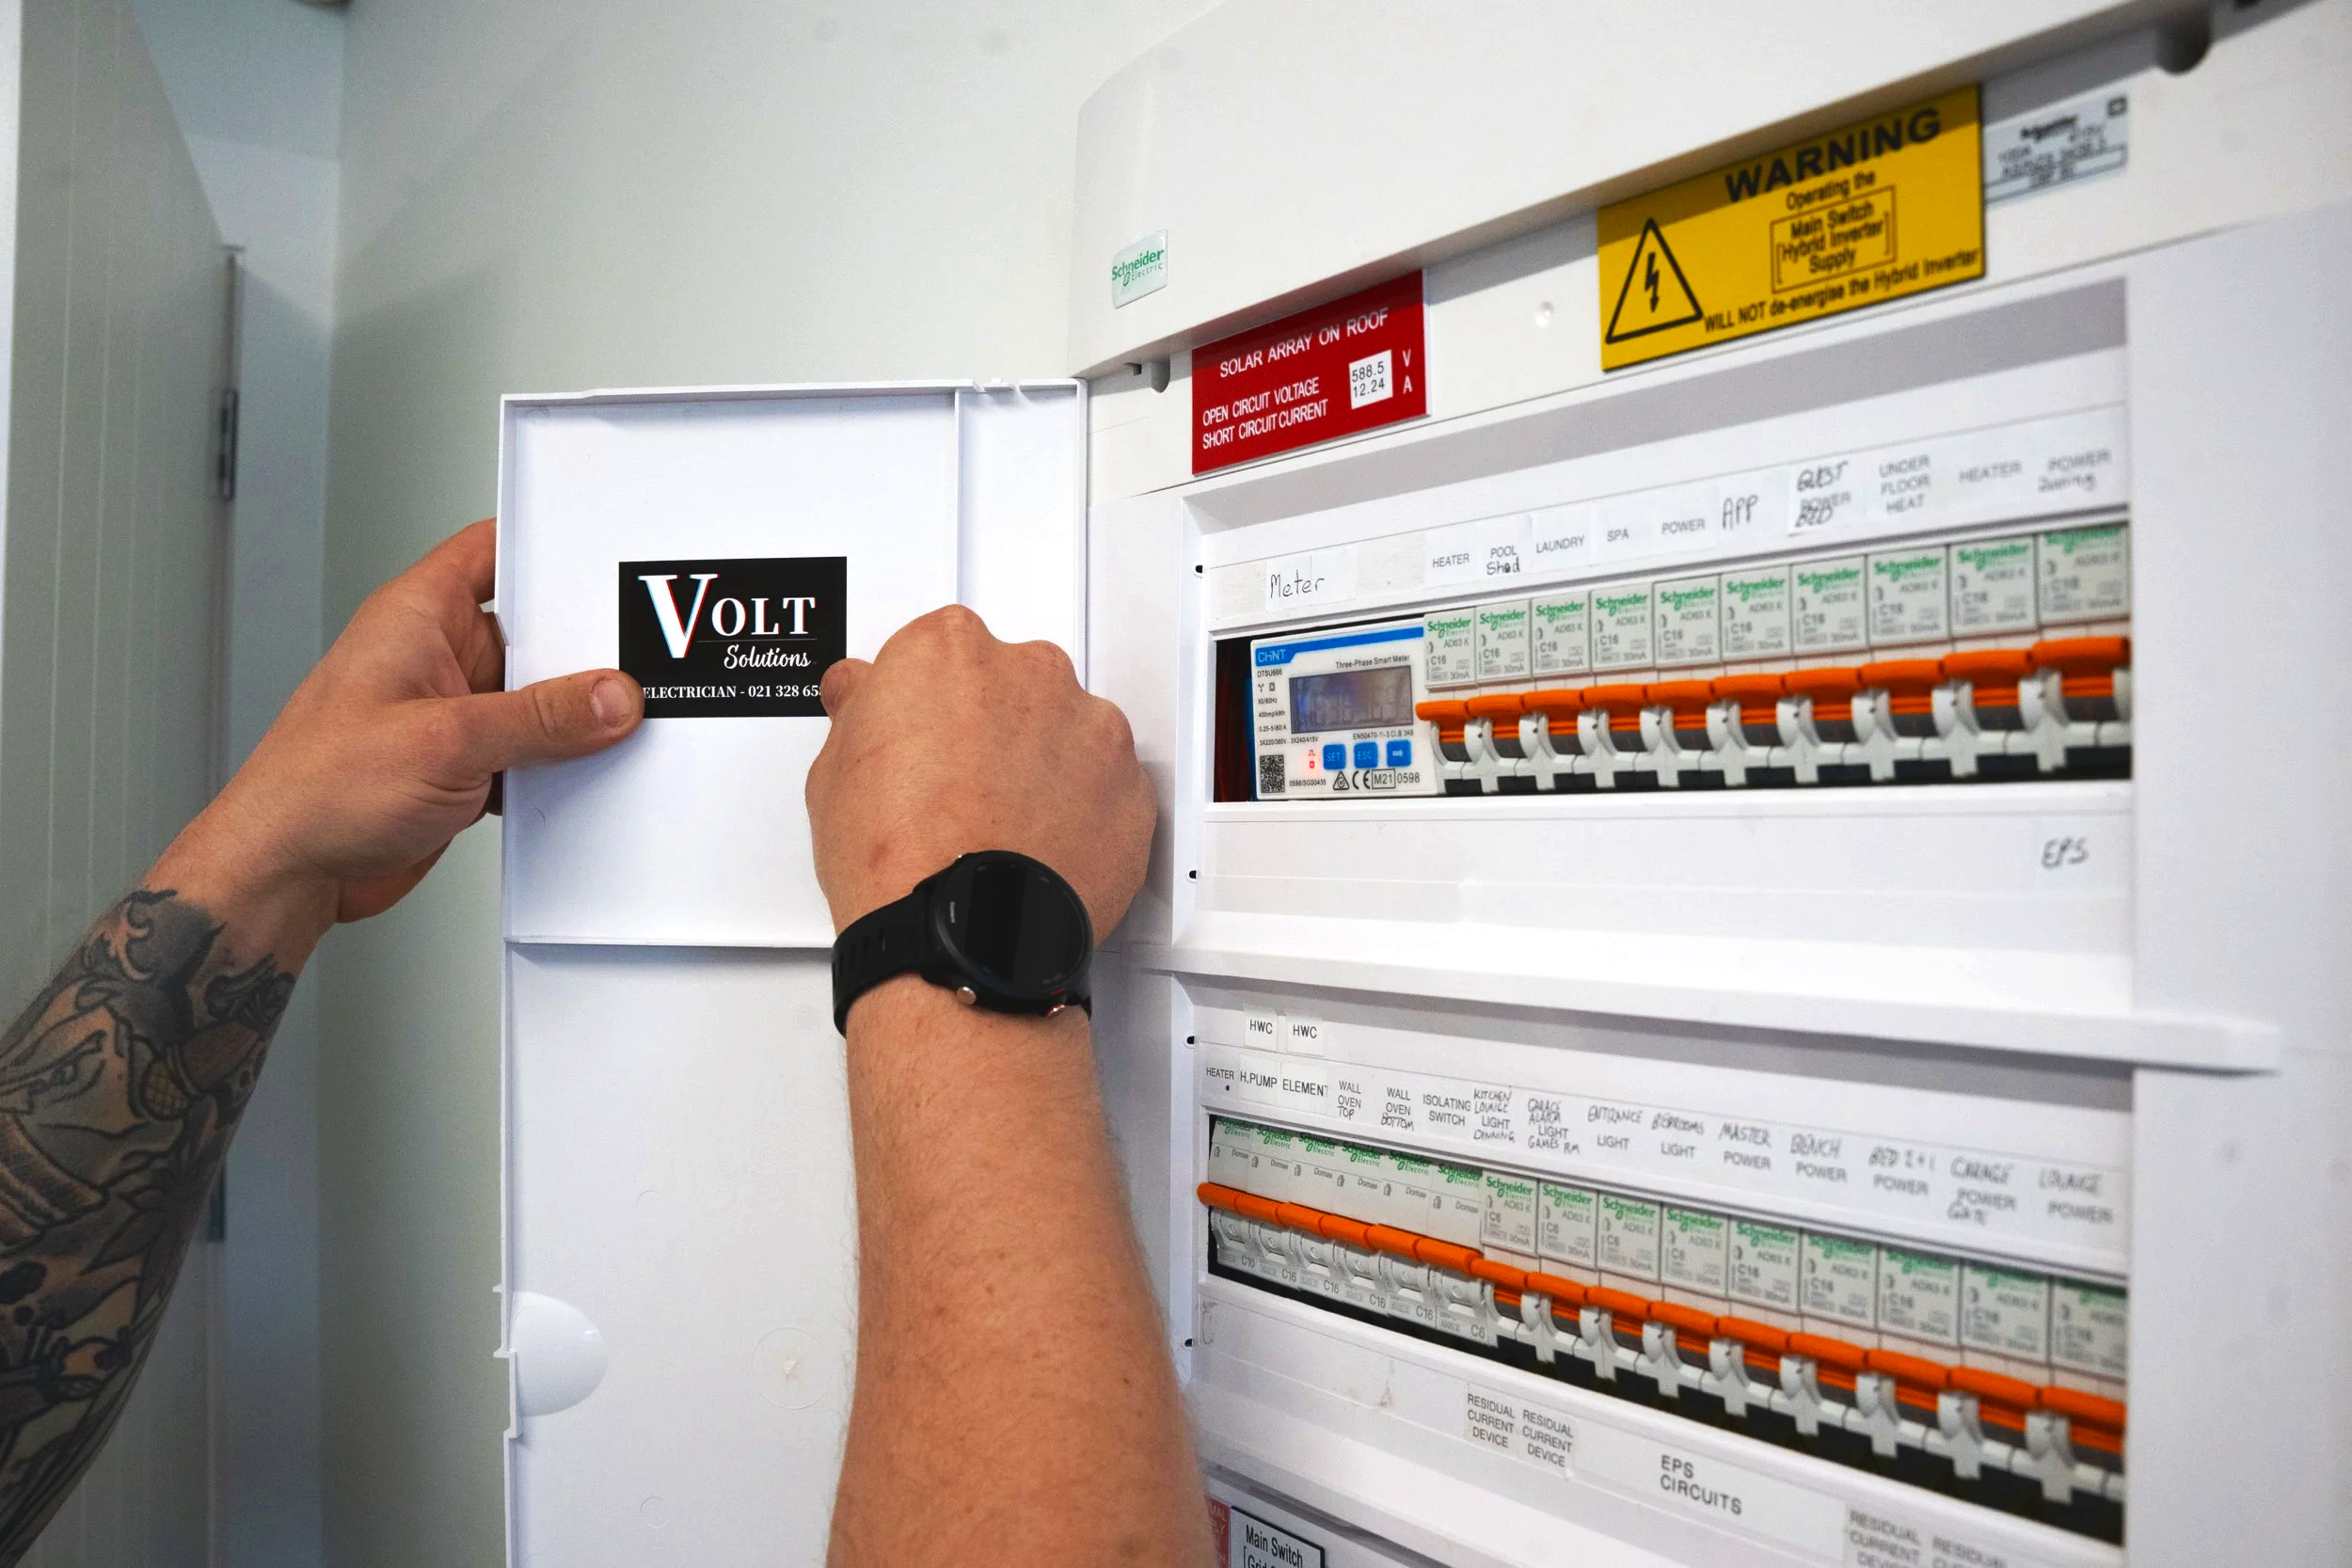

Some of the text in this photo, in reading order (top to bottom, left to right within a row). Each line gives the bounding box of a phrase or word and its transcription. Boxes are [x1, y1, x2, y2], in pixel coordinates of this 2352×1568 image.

[1725, 107, 1942, 203] WARNING
[1786, 170, 1877, 212] Operating the
[1790, 200, 1875, 239] Main Switch
[1782, 218, 1885, 263] Hybrid Inverter
[1111, 249, 1164, 281] Schneider
[1808, 247, 1857, 276] Supply
[1132, 262, 1163, 280] Electric
[1703, 248, 1978, 334] WILL NOT de-energise the Hybrid Inverter
[1219, 307, 1390, 378] SOLAR ARRAY ON ROOF
[1402, 348, 1411, 368] V
[1351, 360, 1385, 384] 588.5
[1352, 377, 1385, 399] 12.24
[1402, 374, 1412, 395] A
[1202, 376, 1320, 427] OPEN CIRCUIT VOLTAGE
[1202, 399, 1328, 451] SHORT CIRCUIT CURRENT
[1879, 455, 1931, 476] UNDER
[1959, 461, 2022, 483] HEATER
[1880, 475, 1931, 496] FLOOR
[1886, 493, 1926, 515] HEAT
[1661, 518, 1705, 535] POWER
[1535, 535, 1585, 554] LAUNDRY
[1607, 529, 1629, 543] SPA
[1432, 553, 1470, 569] HEATER
[1490, 545, 1518, 560] POOL
[1270, 569, 1325, 599] Meter
[1596, 594, 1648, 610] Schneider
[1661, 588, 1715, 604] Schneider
[638, 573, 817, 658] VOLT
[1479, 610, 1526, 625] Schneider
[1535, 601, 1585, 617] Schneider
[1427, 617, 1471, 632] Schneider
[723, 643, 811, 670] Solutions
[1430, 656, 1447, 665] C16
[1483, 648, 1501, 659] C16
[1336, 658, 1373, 670] Three-Phase
[1374, 657, 1392, 665] Smart
[644, 686, 737, 699] ELECTRICIAN
[749, 685, 773, 698] 021
[775, 685, 800, 698] 328
[1327, 752, 1342, 763] SET
[1357, 751, 1374, 761] ESC
[1375, 773, 1392, 784] M21
[1396, 772, 1421, 784] 0598
[1249, 1020, 1274, 1035] HWC
[1293, 1024, 1317, 1039] HWC
[1205, 1067, 1234, 1081] HEATER
[1240, 1070, 1278, 1088] H.PUMP
[1282, 1079, 1328, 1098] ELEMENT
[1338, 1080, 1362, 1095] WALL
[1386, 1086, 1411, 1101] WALL
[1473, 1088, 1513, 1102] KITCHEN
[1338, 1095, 1362, 1110] OVEN
[1385, 1101, 1411, 1117] OVEN
[1422, 1094, 1471, 1113] ISOLATING
[1337, 1105, 1356, 1120] TOP
[1428, 1110, 1466, 1127] SWITCH
[1380, 1112, 1415, 1131] BOTTOM
[1482, 1116, 1511, 1130] LIGHT
[1231, 1131, 1250, 1139] Electric
[1257, 1128, 1293, 1143] Schneider
[1298, 1132, 1336, 1149] Schneider
[1538, 1124, 1569, 1140] LIGHT
[1718, 1121, 1772, 1148] MASTER
[1270, 1140, 1291, 1149] Electric
[1528, 1134, 1559, 1149] GAMES
[1597, 1134, 1629, 1151] LIGHT
[1312, 1148, 1335, 1158] Electric
[1343, 1141, 1381, 1160] Schneider
[1389, 1149, 1431, 1169] Schneider
[1661, 1142, 1695, 1159] LIGHT
[1358, 1157, 1380, 1167] Electric
[1724, 1150, 1772, 1171] POWER
[1405, 1166, 1429, 1177] Electric
[1437, 1163, 1484, 1182] Schneider
[1796, 1162, 1848, 1184] POWER
[1454, 1178, 1480, 1189] Electric
[1486, 1176, 1533, 1196] Schneider
[1543, 1184, 1593, 1205] Schneider
[1603, 1196, 1656, 1217] Schneider
[1241, 1256, 1256, 1269] C10
[1281, 1268, 1297, 1283] C16
[1323, 1279, 1340, 1294] C16
[1369, 1293, 1386, 1308] C16
[1415, 1305, 1434, 1322] C16
[1470, 1324, 1486, 1339] C6
[1468, 1393, 1516, 1419] RESIDUAL
[1467, 1409, 1515, 1433] CURRENT
[1522, 1409, 1574, 1438] RESIDUAL
[1472, 1426, 1509, 1449] DEVICE
[1522, 1426, 1573, 1453] CURRENT
[1527, 1443, 1566, 1467] DEVICE
[1661, 1454, 1694, 1479] EPS
[1660, 1473, 1742, 1515] CIRCUITS
[1246, 1524, 1303, 1568] Main Switch
